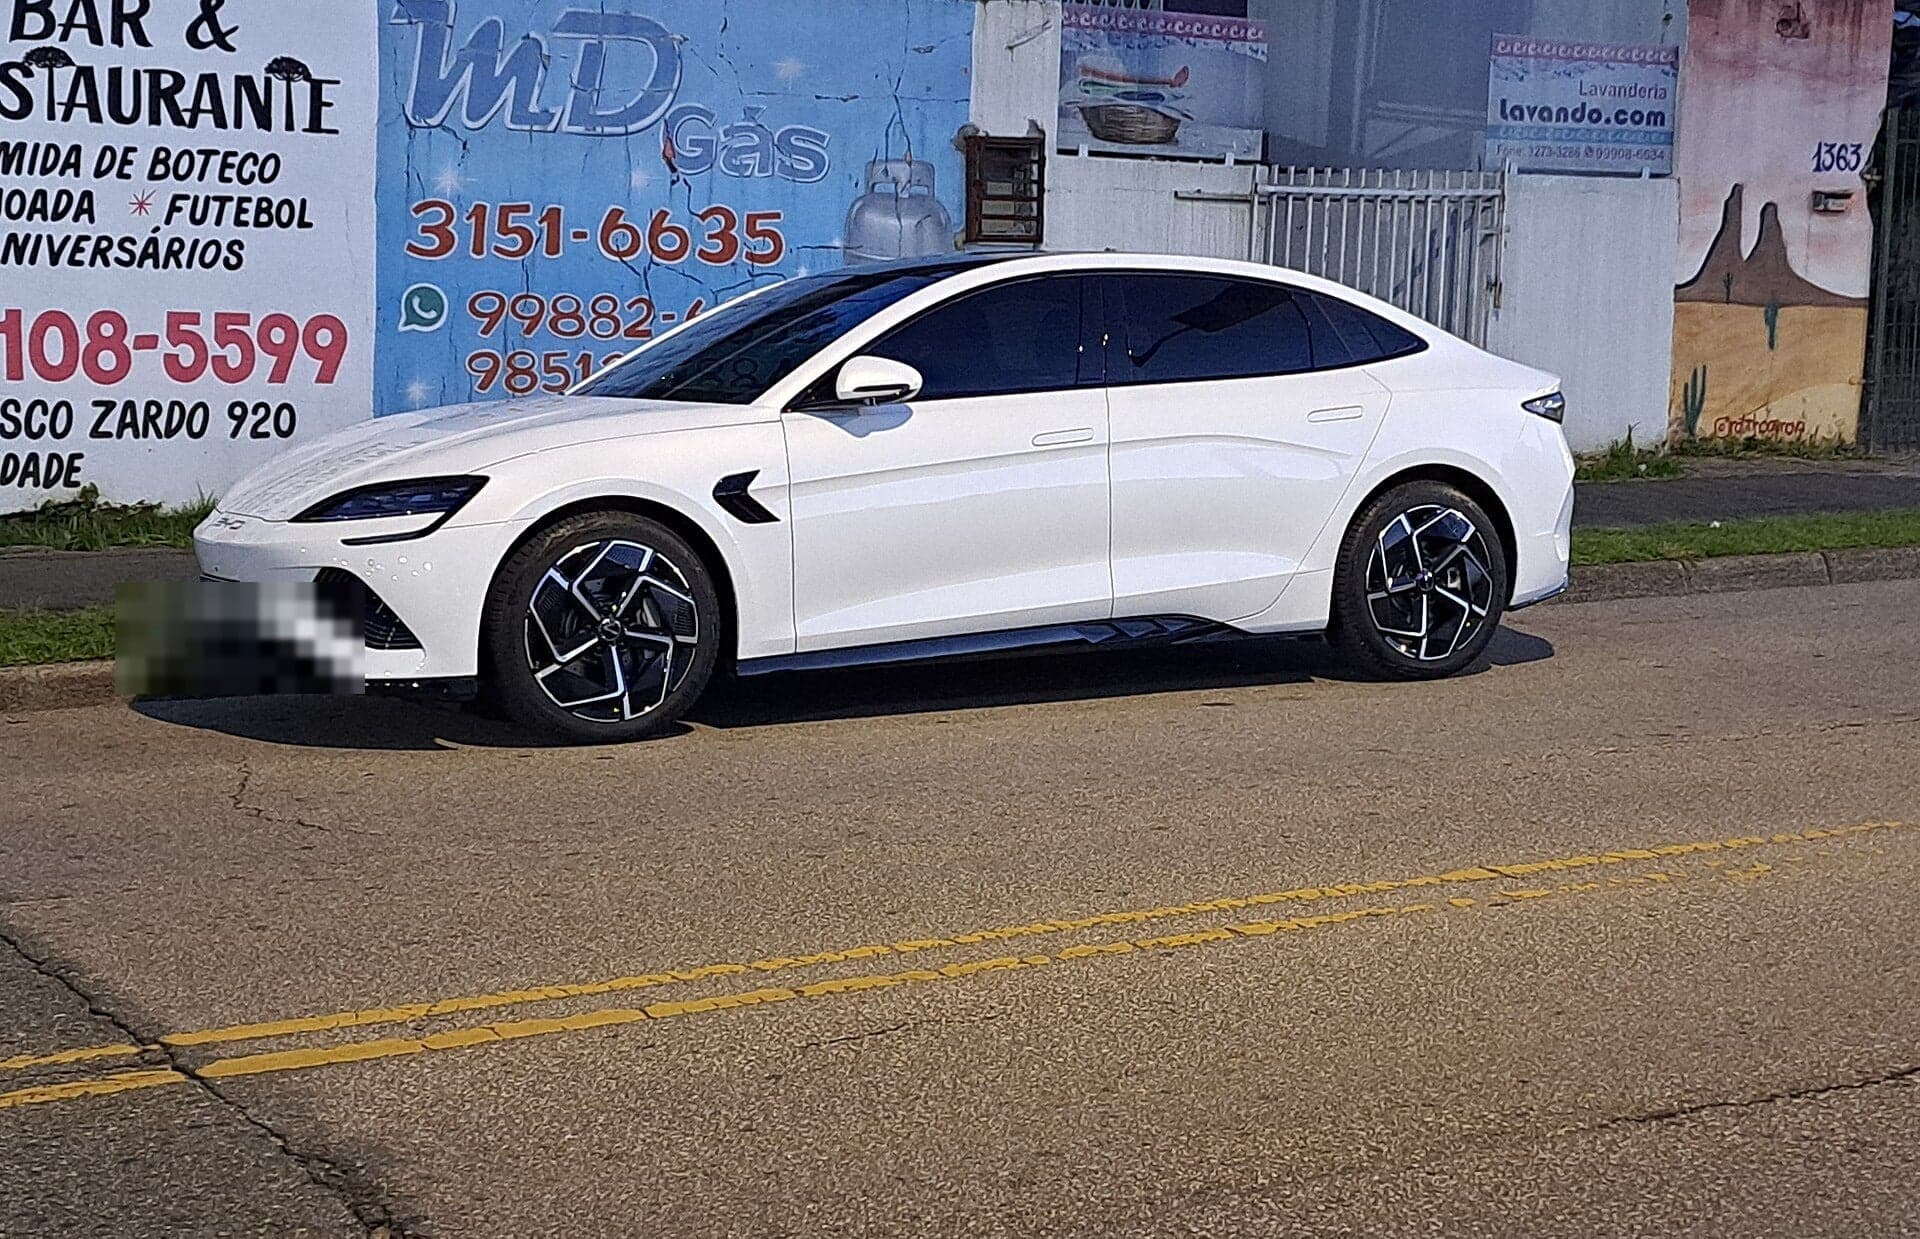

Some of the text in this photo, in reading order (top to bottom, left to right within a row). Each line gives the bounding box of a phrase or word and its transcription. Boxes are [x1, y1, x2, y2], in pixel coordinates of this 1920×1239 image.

[9, 0, 239, 51] BAR &
[1579, 80, 1667, 99] Lavanderia
[0, 141, 281, 186] MIDA DE BOTECO
[1812, 141, 1863, 172] 1363
[0, 187, 313, 229] OADA FUTEBOL
[0, 226, 244, 271] NIVERSÁRIOS
[405, 200, 786, 266] 3151-6635
[0, 309, 347, 385] 108-5599
[465, 350, 625, 397] 9851
[0, 399, 296, 439] SCO ZARDO 920
[0, 452, 84, 489] DADE
